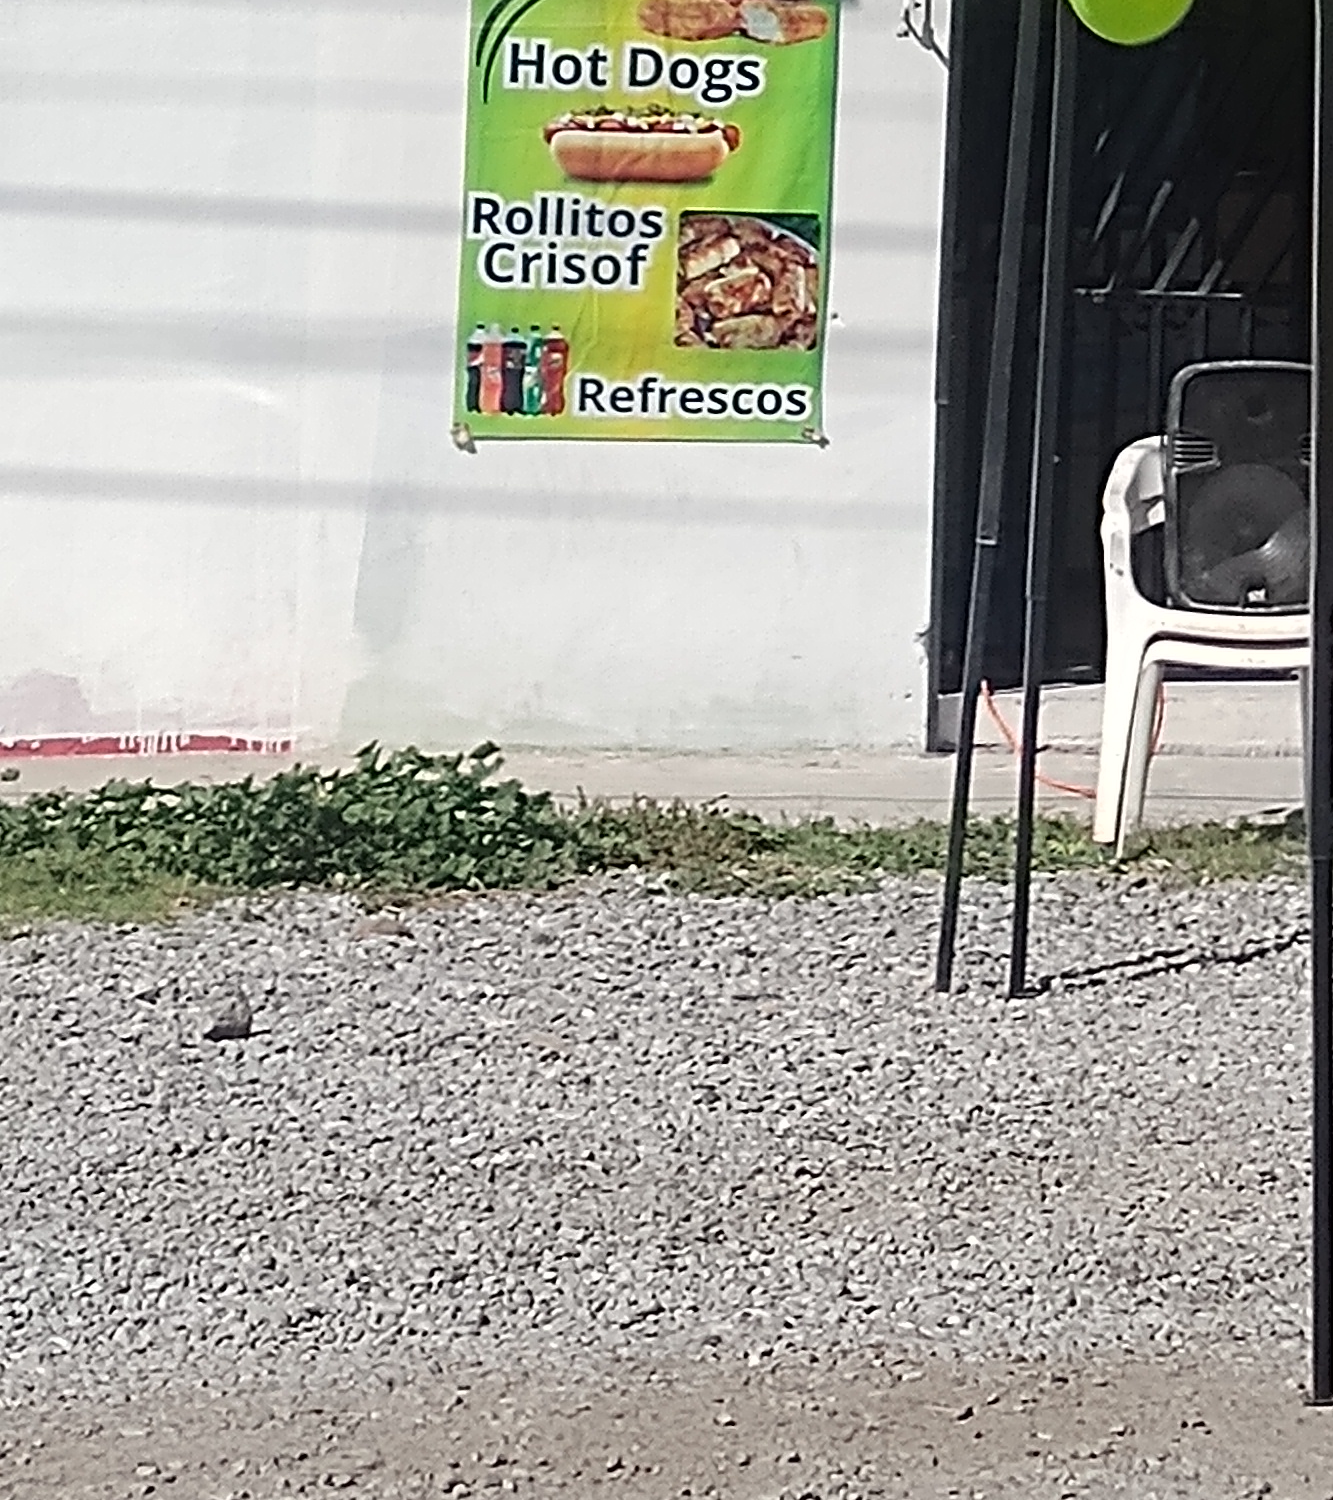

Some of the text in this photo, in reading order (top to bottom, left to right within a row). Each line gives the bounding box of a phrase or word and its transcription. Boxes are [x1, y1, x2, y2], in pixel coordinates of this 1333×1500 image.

[508, 42, 761, 102] Hot Dogs
[471, 196, 664, 239] Rollitos
[482, 241, 649, 286] Crisof
[578, 377, 808, 416] Refrescos
